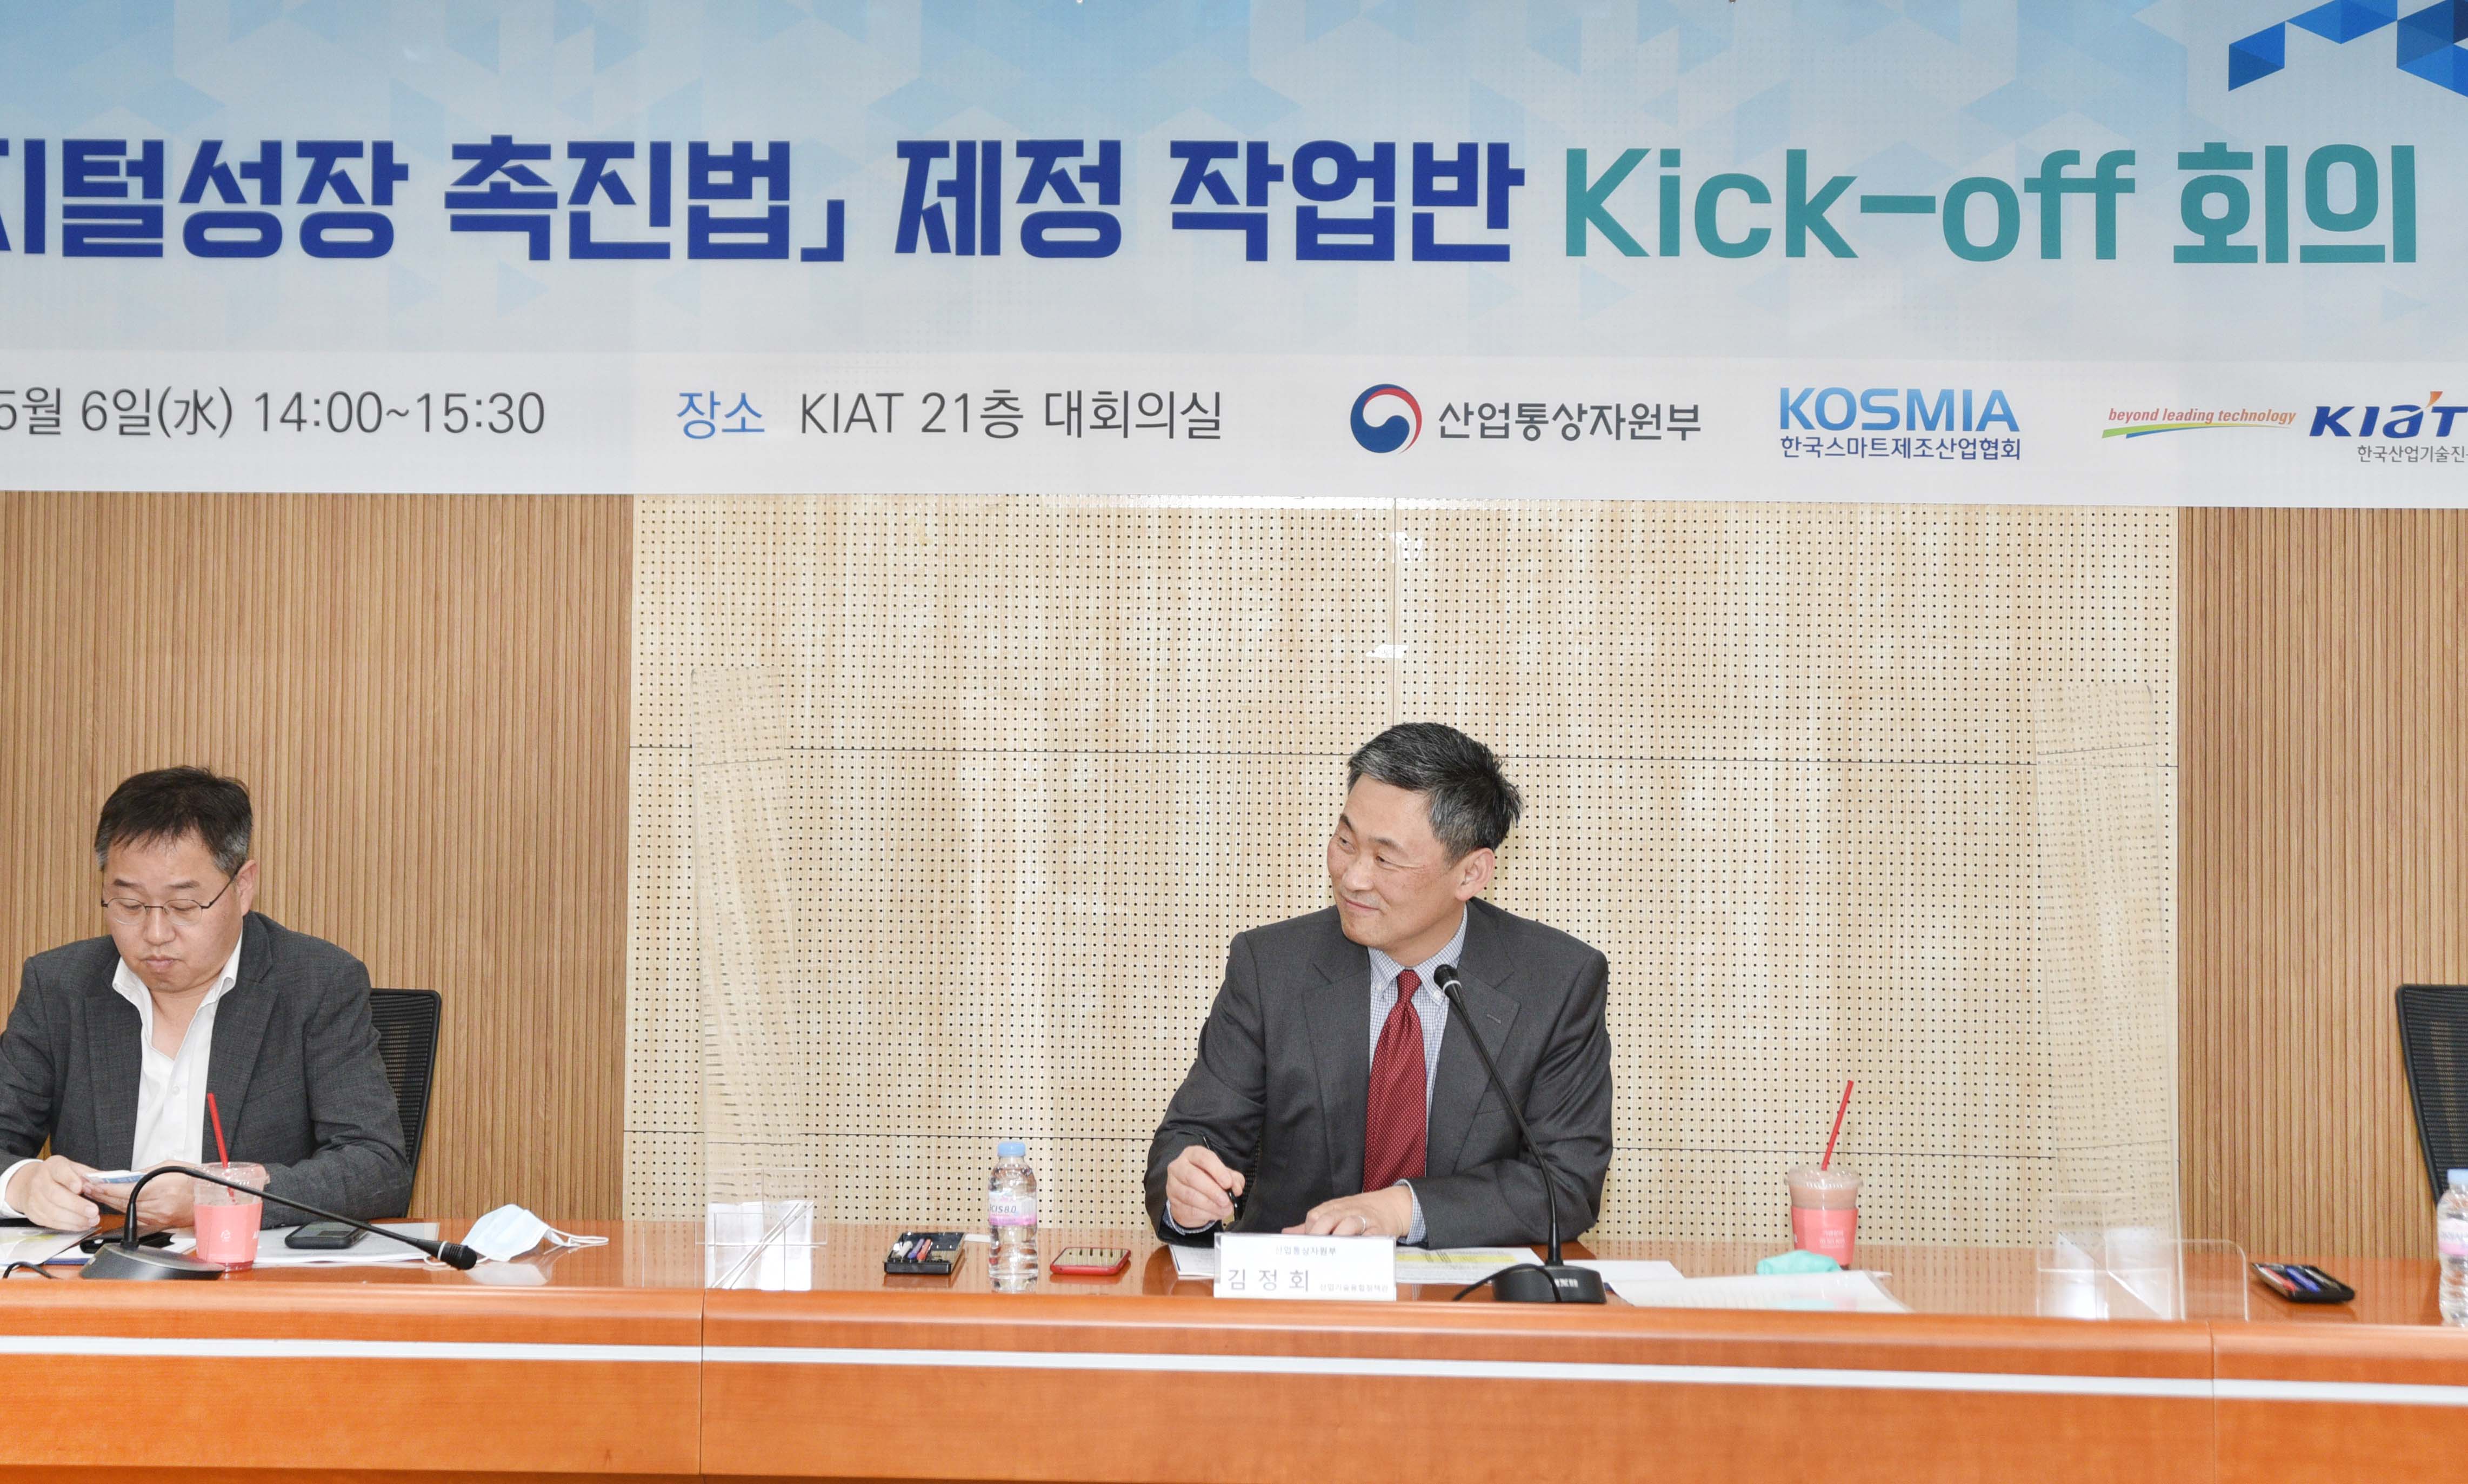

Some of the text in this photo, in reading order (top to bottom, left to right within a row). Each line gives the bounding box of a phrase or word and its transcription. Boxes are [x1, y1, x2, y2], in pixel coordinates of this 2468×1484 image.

[445, 135, 844, 262] 촉진법」
[896, 140, 1121, 258] 제정
[1170, 141, 1525, 262] 작업반
[1565, 148, 2136, 262] Kick-off
[2174, 142, 2416, 263] 회의
[81, 386, 232, 438] 6일(水)
[255, 390, 544, 434] 14:00~15:30
[676, 389, 1222, 440] 장소 KIAT 21층 대회의실
[1438, 402, 1701, 442] 산업통상자원부
[1780, 387, 2020, 432] KOSMIA
[2108, 408, 2297, 425] beyond leading technology
[1780, 435, 2020, 460] 한국스마트제조산업협회
[2357, 445, 2468, 463] 한국산업기술진
